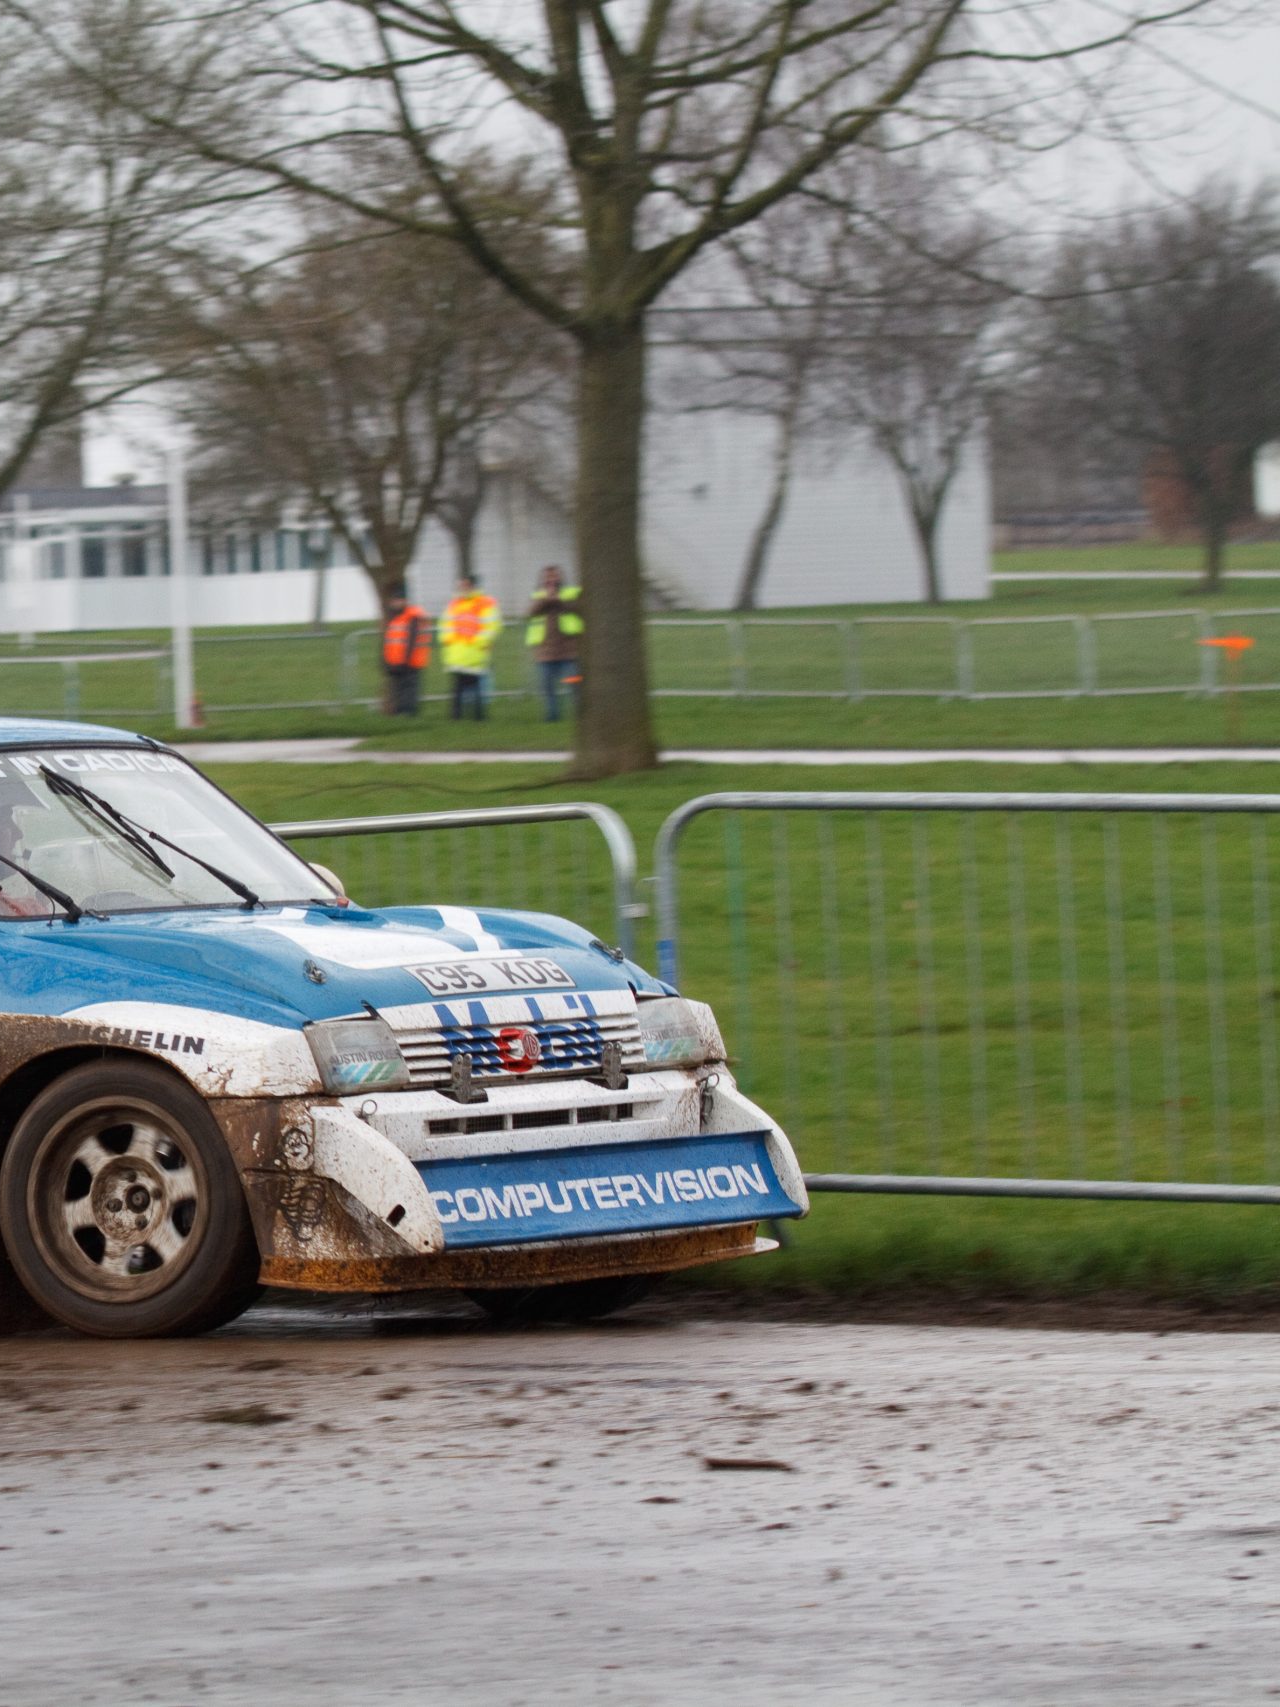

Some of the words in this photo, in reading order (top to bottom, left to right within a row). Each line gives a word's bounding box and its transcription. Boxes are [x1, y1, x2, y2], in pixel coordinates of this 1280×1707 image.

[415, 964, 487, 991] C95
[491, 960, 569, 985] KOG
[55, 1021, 205, 1055] MICHELIN
[428, 1163, 769, 1224] COMPUTERVISION
